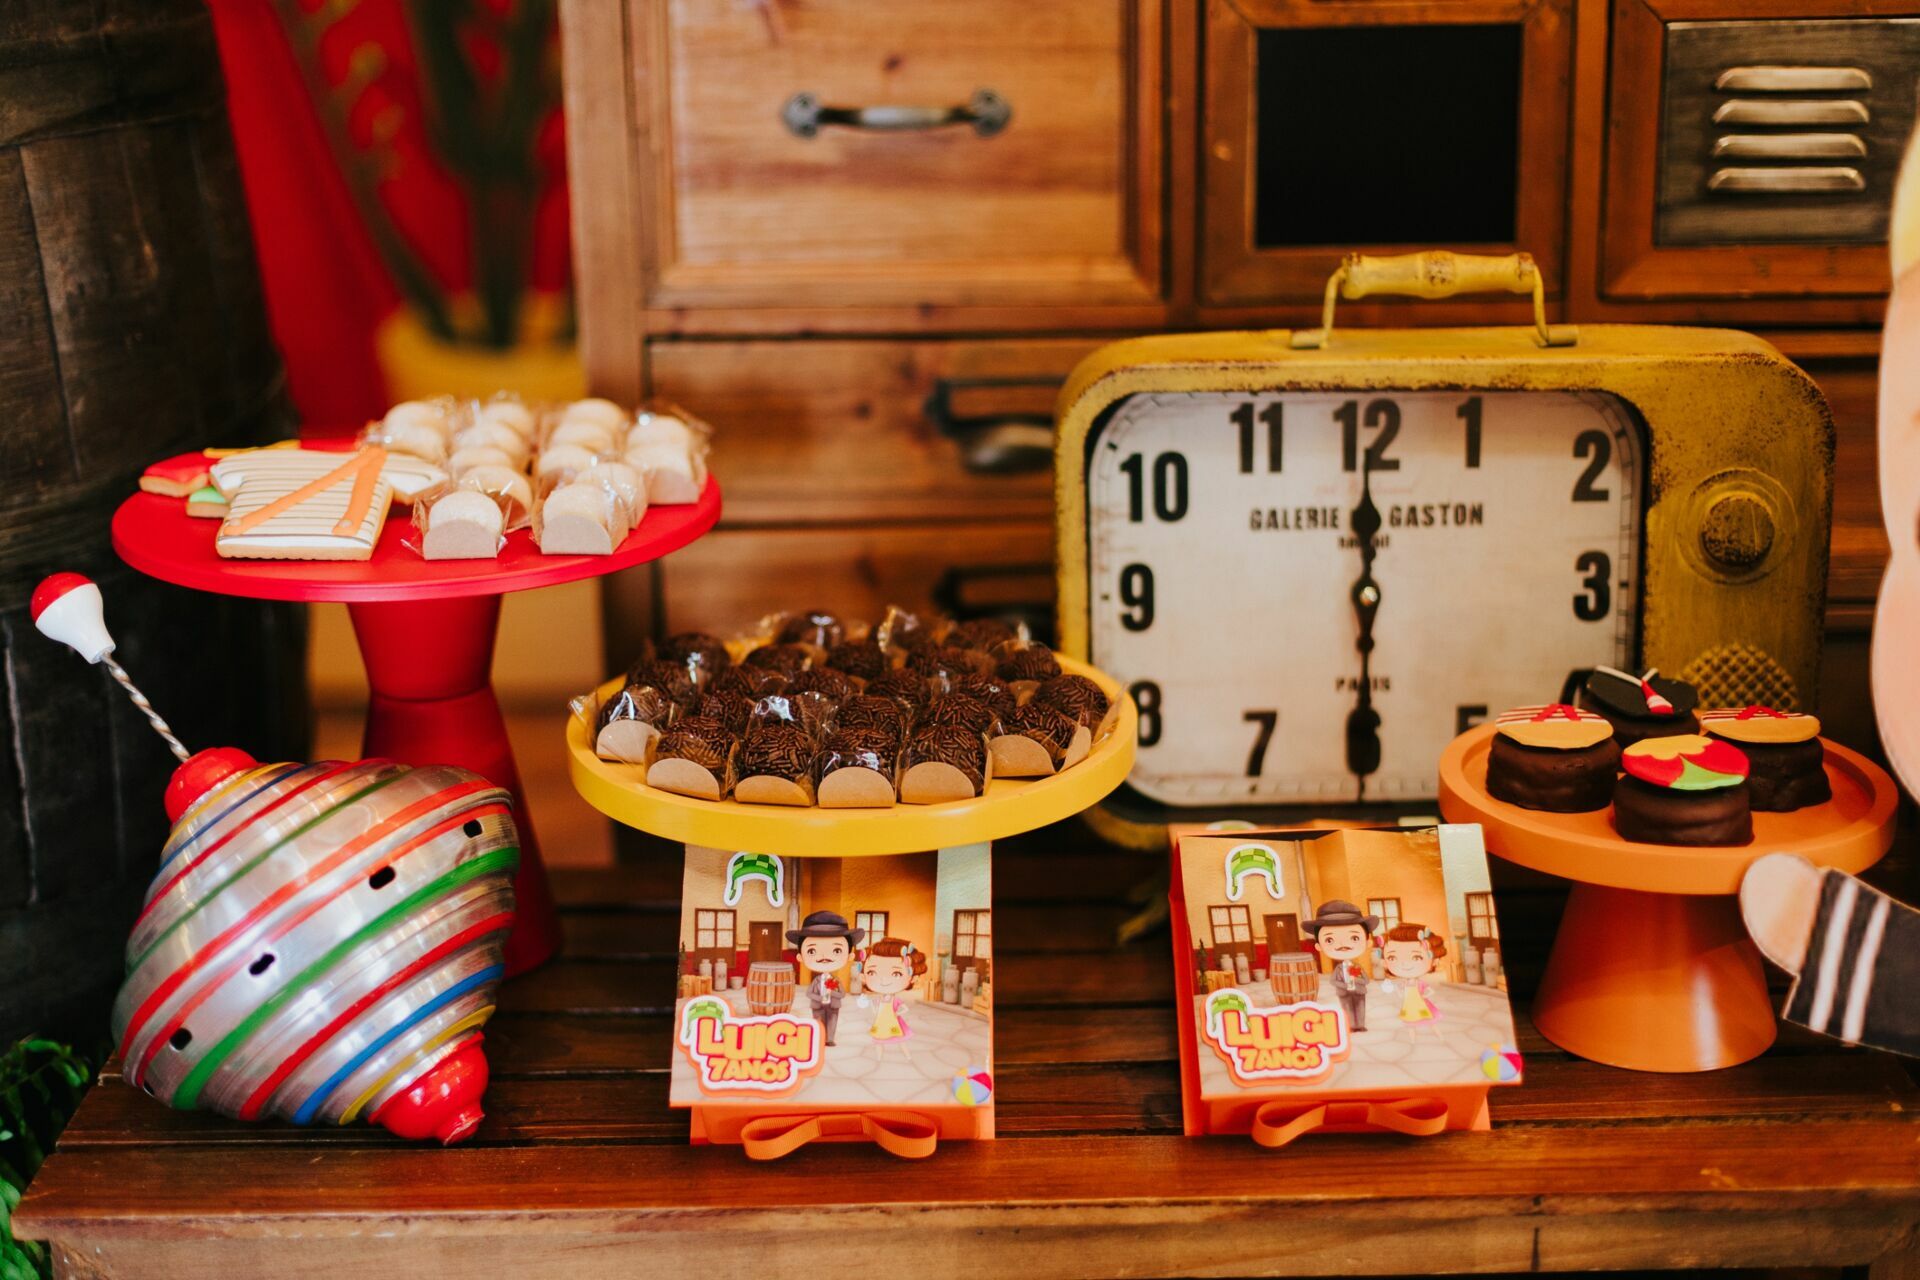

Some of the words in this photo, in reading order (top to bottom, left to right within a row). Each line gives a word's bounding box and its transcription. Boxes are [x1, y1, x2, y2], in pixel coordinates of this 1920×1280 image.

[1229, 401, 1284, 475] 11
[1333, 397, 1402, 474] 12
[1456, 396, 1484, 470] 1
[1571, 429, 1612, 503] 2
[1119, 450, 1189, 524] 10
[1249, 507, 1340, 530] GALERIE
[1389, 502, 1485, 527] GASTON
[1119, 562, 1155, 633] 9
[1572, 550, 1612, 622] 3
[1130, 680, 1163, 749] 8
[1335, 677, 1392, 692] PAIS
[1243, 710, 1278, 778] 7
[697, 1016, 813, 1062] LUIGI
[1222, 1008, 1340, 1048] LUIGI
